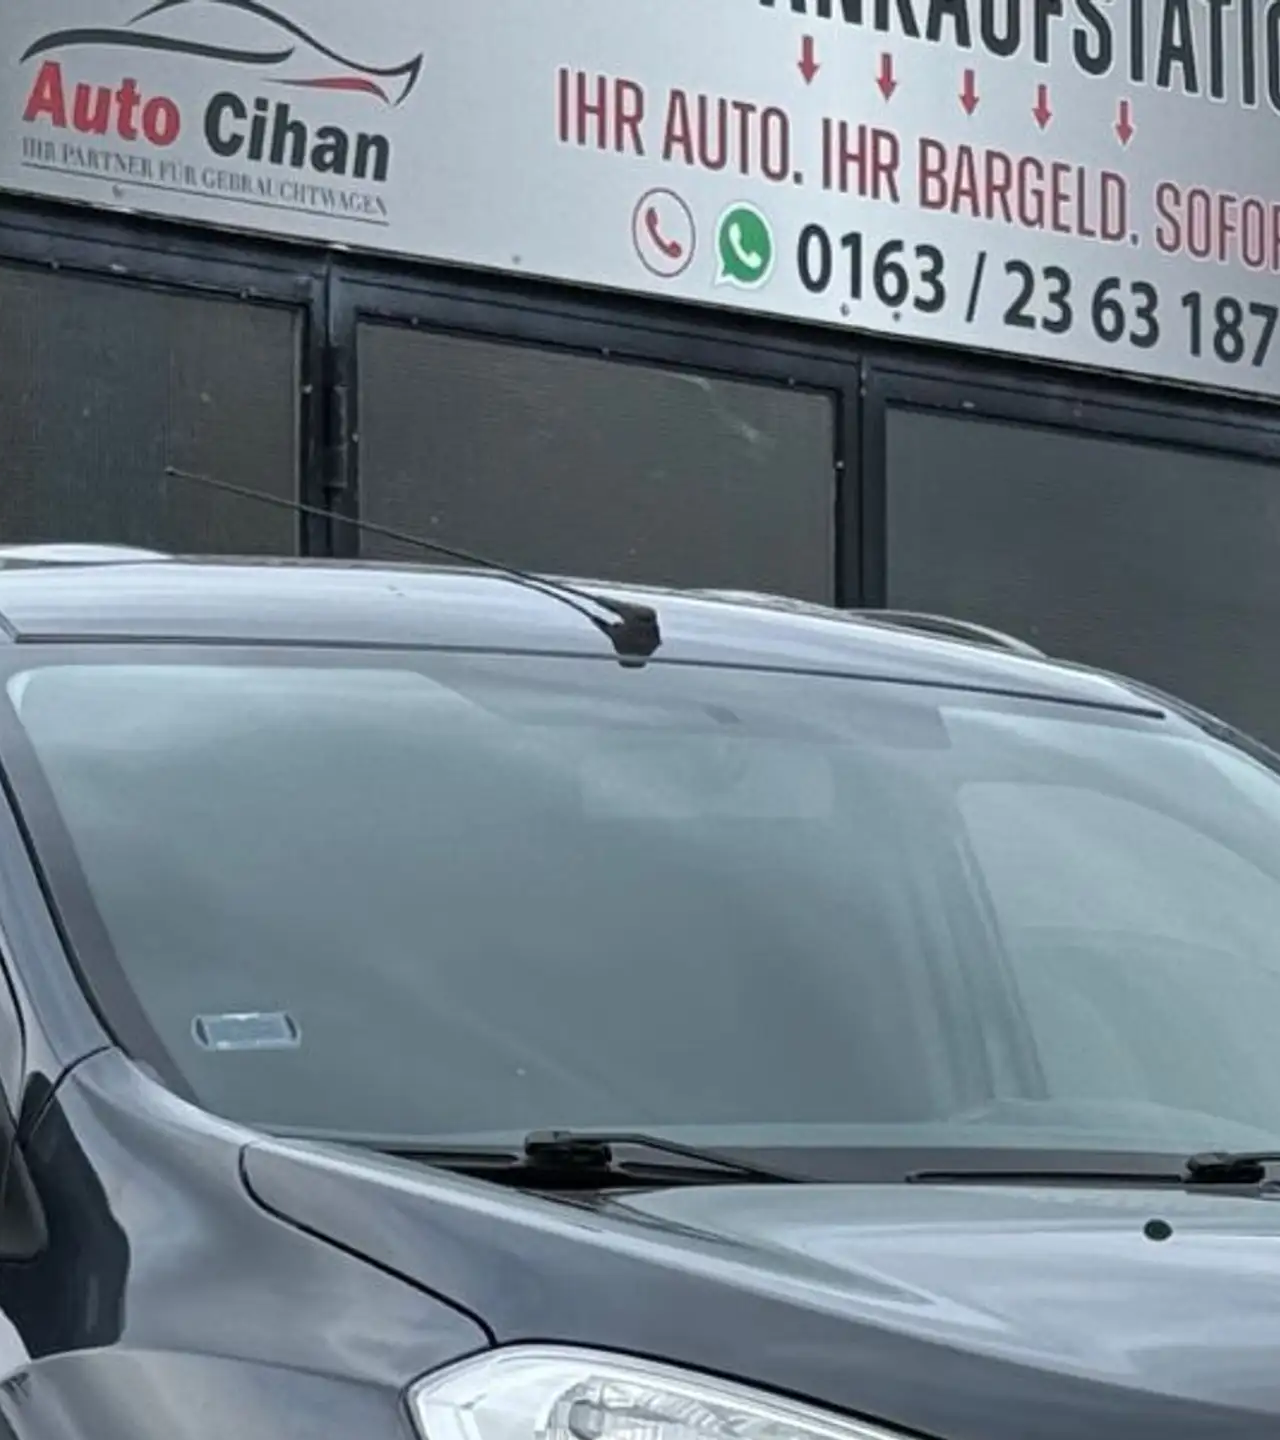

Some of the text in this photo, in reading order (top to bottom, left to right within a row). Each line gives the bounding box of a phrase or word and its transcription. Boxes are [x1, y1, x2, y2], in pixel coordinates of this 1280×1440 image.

[22, 60, 390, 182] Auto Cihan
[22, 136, 390, 217] IHR PARTNER FÜR GEBRAUCHTWAGEN
[558, 67, 645, 156] IHR
[663, 88, 803, 185] AUTO.
[822, 117, 900, 203] IHR
[919, 137, 1139, 246] BARGELD.
[796, 223, 946, 312] 0163
[1004, 259, 1074, 334] 23
[1091, 275, 1161, 349] 63
[1180, 290, 1279, 367] 187
